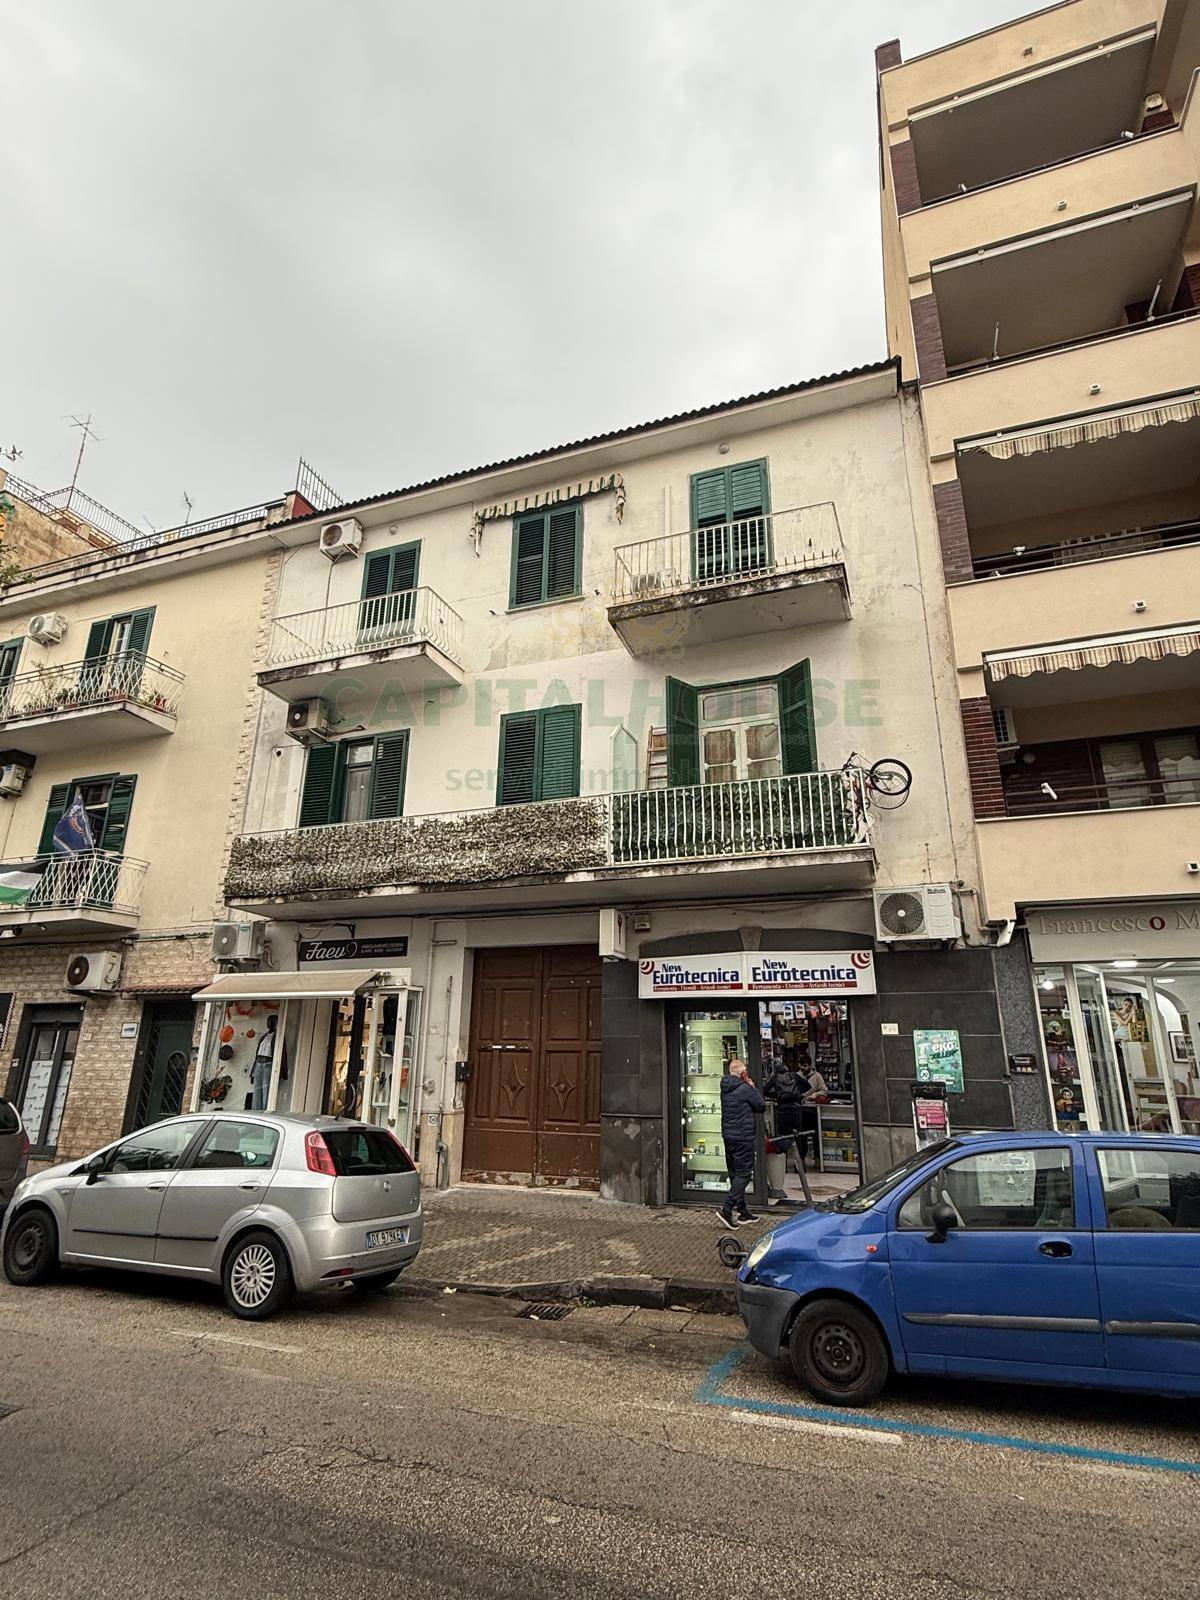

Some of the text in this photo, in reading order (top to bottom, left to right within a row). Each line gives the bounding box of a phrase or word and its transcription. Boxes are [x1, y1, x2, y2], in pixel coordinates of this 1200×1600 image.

[1039, 915, 1166, 936] Francesco
[662, 963, 682, 973] New
[762, 959, 787, 969] New
[653, 968, 740, 985] Eurotecnica
[752, 965, 857, 982] Eurotecnica
